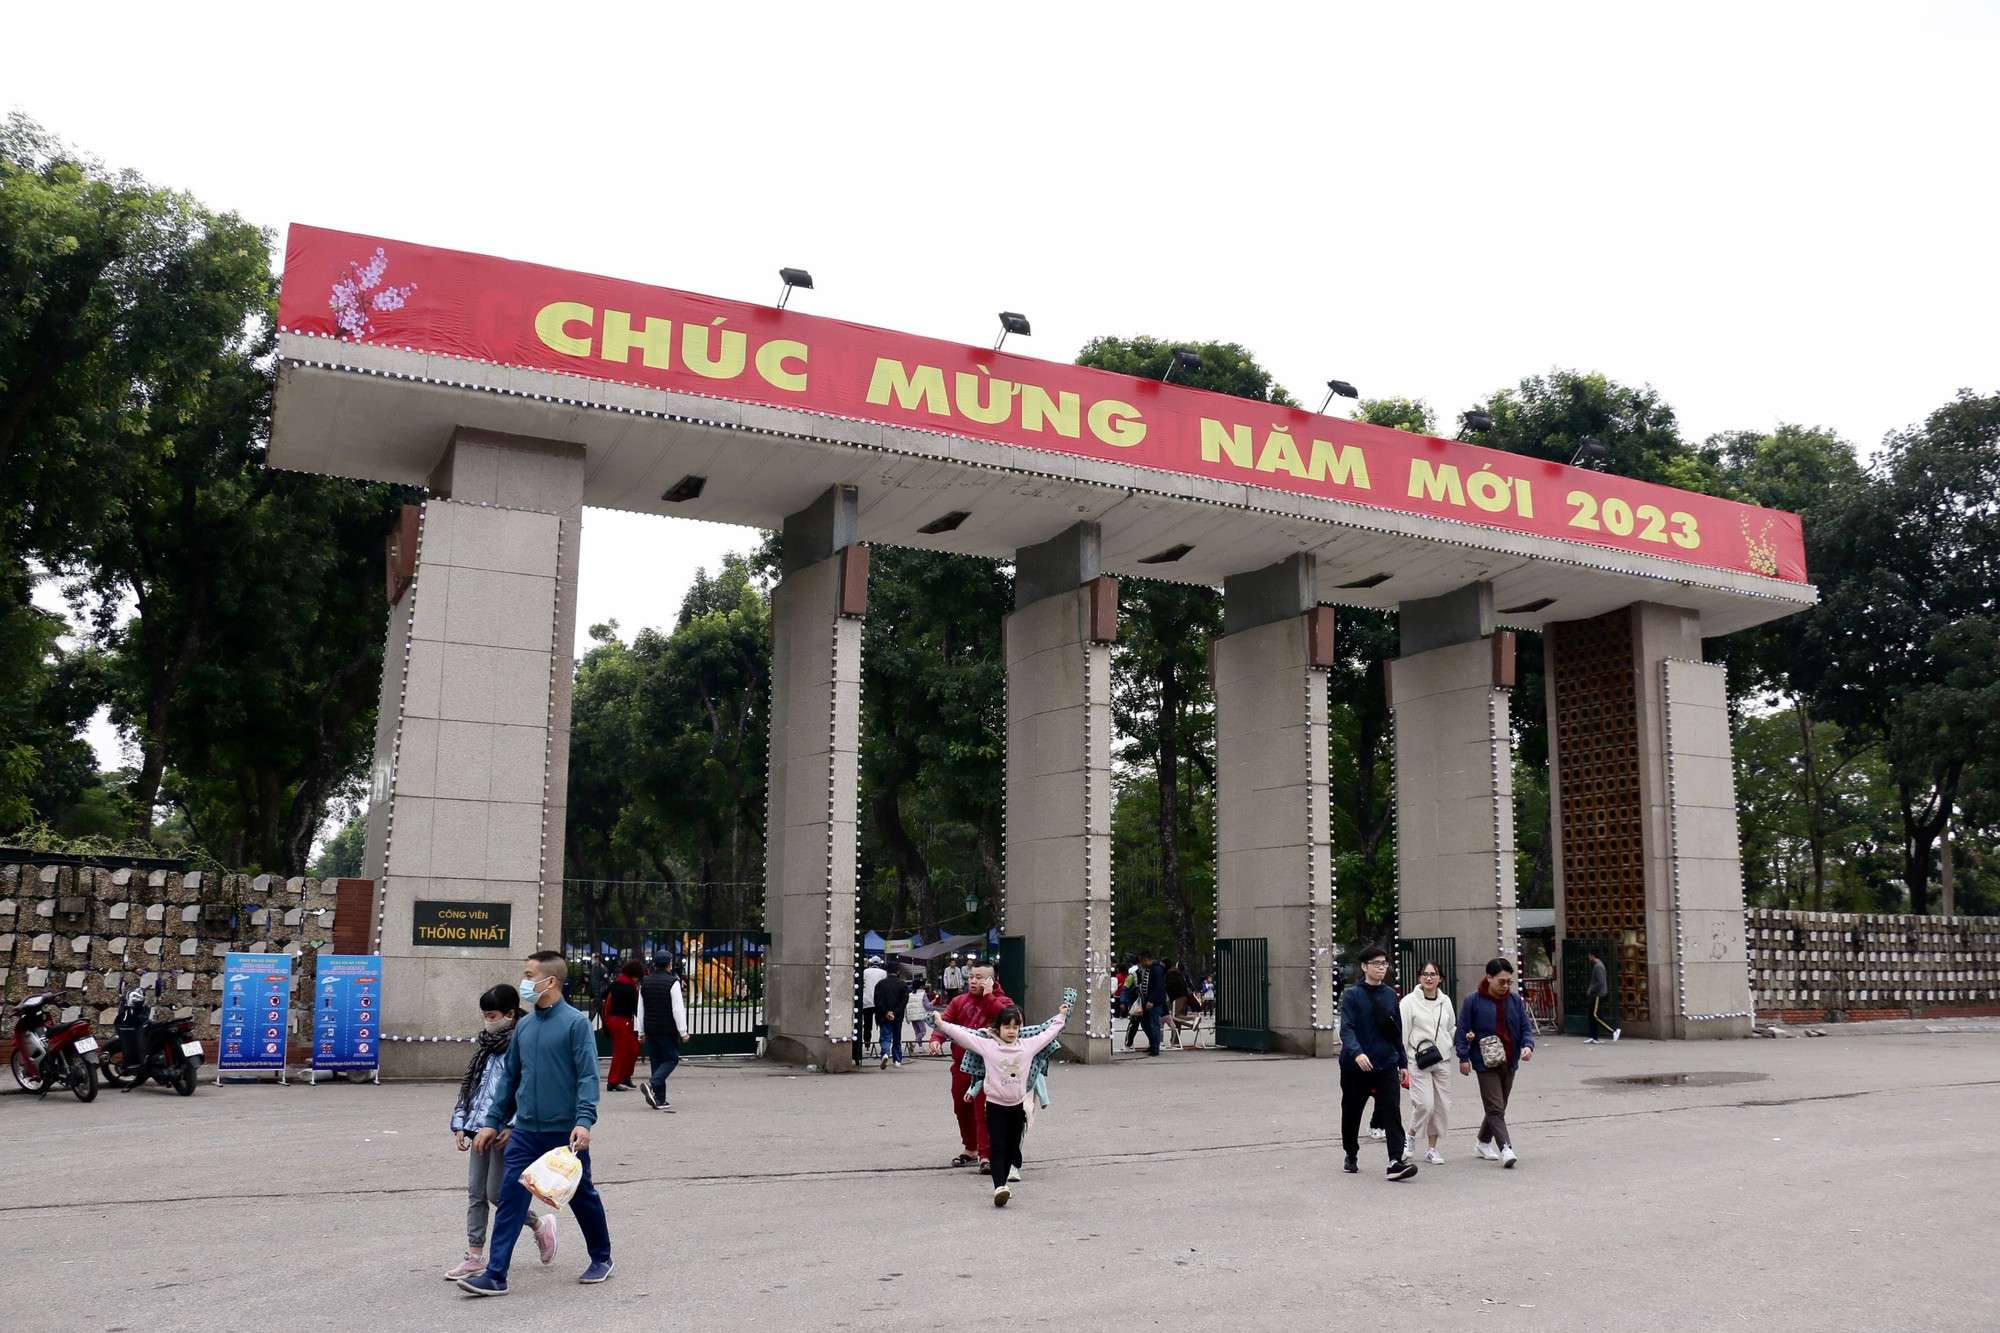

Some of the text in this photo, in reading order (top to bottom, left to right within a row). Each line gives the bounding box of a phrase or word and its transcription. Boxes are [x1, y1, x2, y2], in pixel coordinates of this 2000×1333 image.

[534, 301, 1700, 549] CHÚC MỪNG NĂM MỚI 2023
[438, 908, 489, 919] CÔNG VIÊN
[418, 922, 506, 940] THỐNG NHẤT
